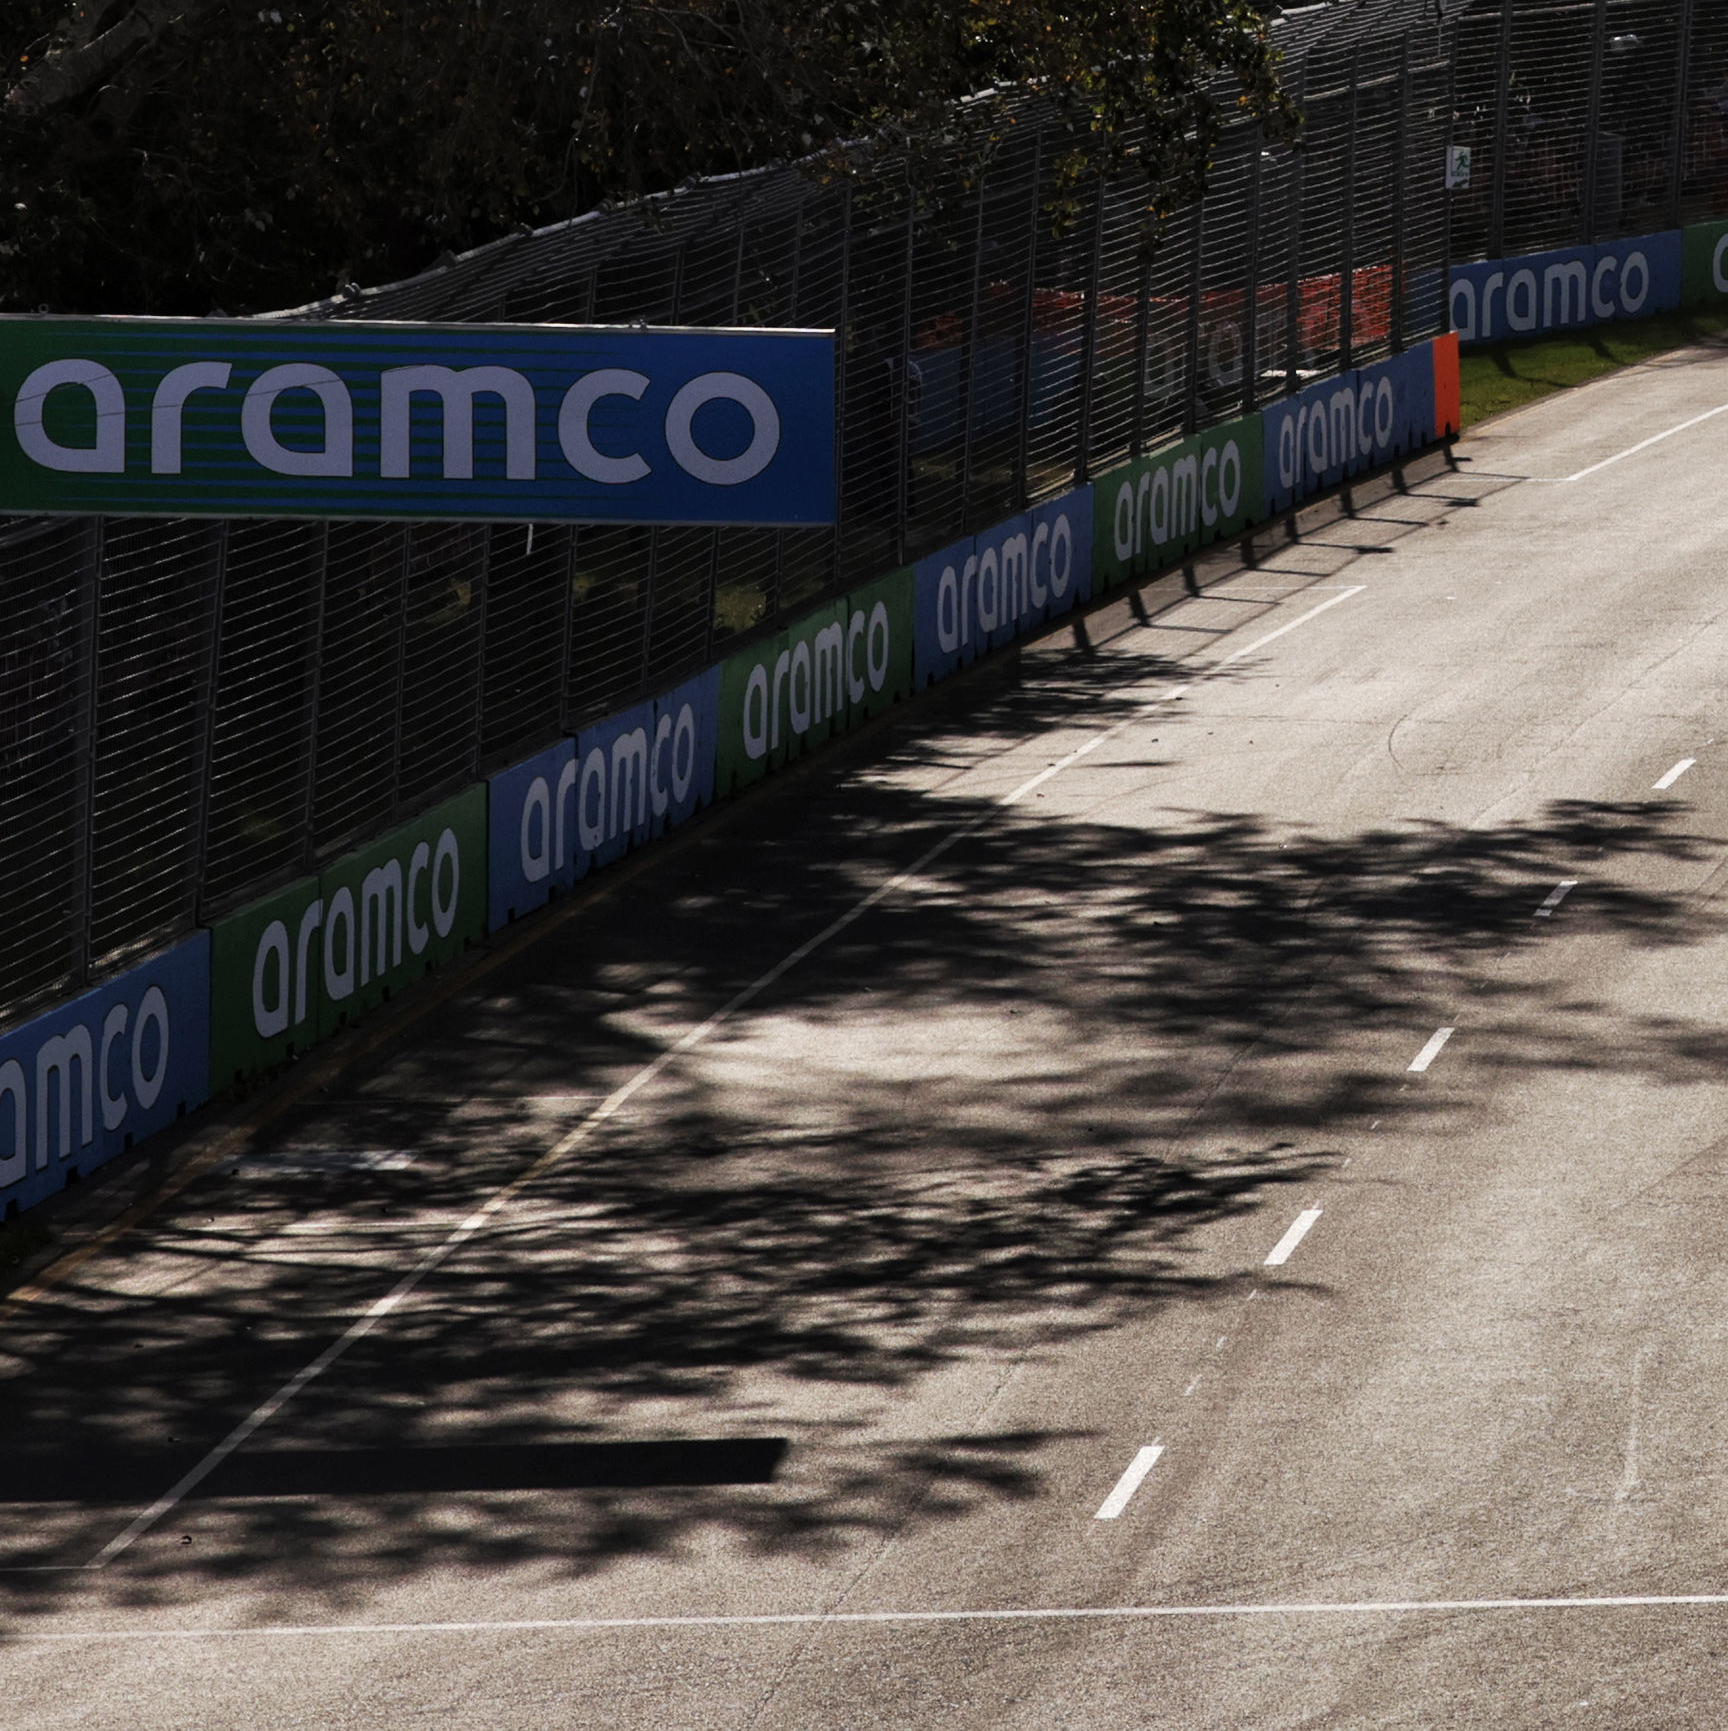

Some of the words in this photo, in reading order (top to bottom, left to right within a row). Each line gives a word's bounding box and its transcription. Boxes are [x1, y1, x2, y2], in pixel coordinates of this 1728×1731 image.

[1452, 251, 1649, 341] aramco
[14, 359, 780, 485] aramco
[1279, 376, 1393, 489] aramco
[1114, 440, 1241, 562] aramco
[938, 514, 1071, 654] aramco
[743, 600, 889, 759] aramco
[521, 703, 694, 883] aramco
[252, 828, 460, 1039] aramco
